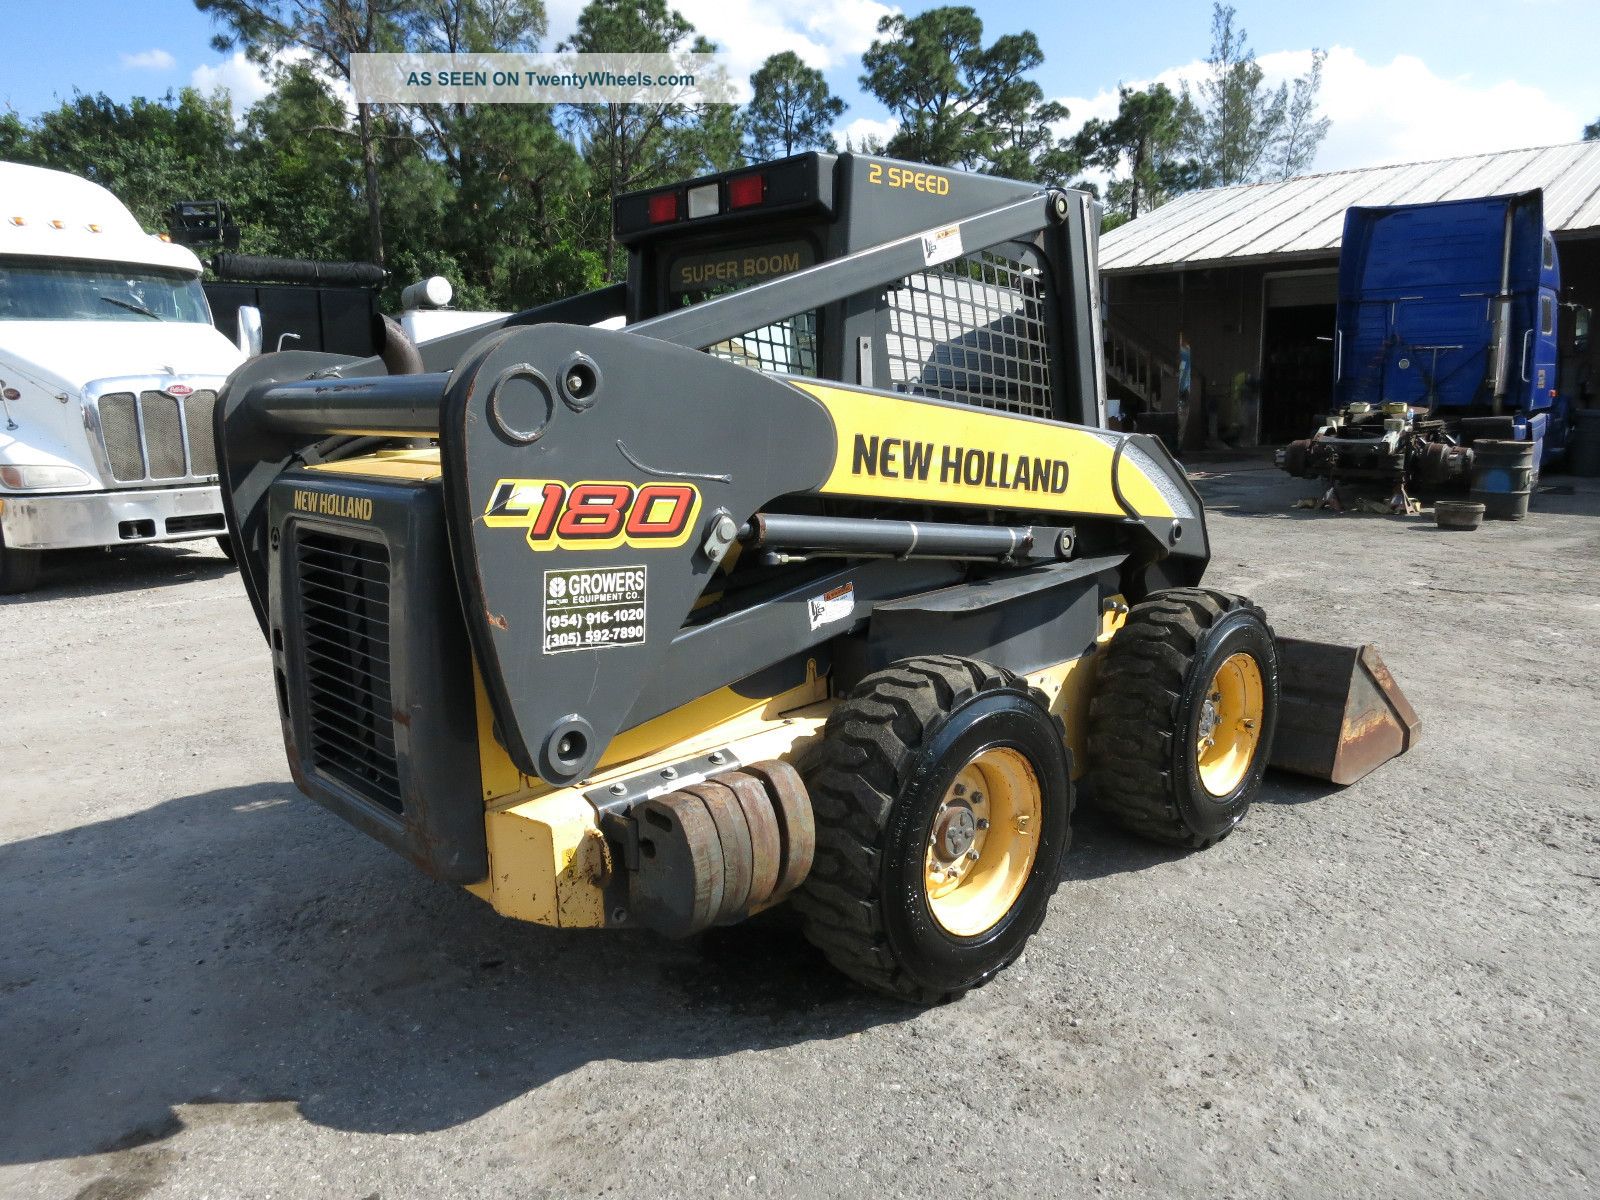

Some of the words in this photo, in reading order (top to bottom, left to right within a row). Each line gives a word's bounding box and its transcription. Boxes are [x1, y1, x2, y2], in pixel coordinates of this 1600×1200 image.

[869, 163, 882, 184] 2
[888, 167, 950, 196] SPEED
[681, 260, 738, 284] SUPER
[743, 252, 800, 277] BOOM
[851, 432, 935, 481] NEW
[939, 443, 1070, 495] HOLLAND
[293, 489, 318, 513] NEW
[319, 492, 373, 522] HOLLAND
[484, 480, 700, 545] L180
[568, 570, 644, 596] GROWERS
[572, 592, 624, 604] EQUIPMENT
[625, 591, 641, 600] CO.
[546, 613, 583, 631] (954)
[585, 607, 644, 625] 916-1020
[545, 631, 582, 650] (305)
[584, 625, 644, 644] 592-7890
